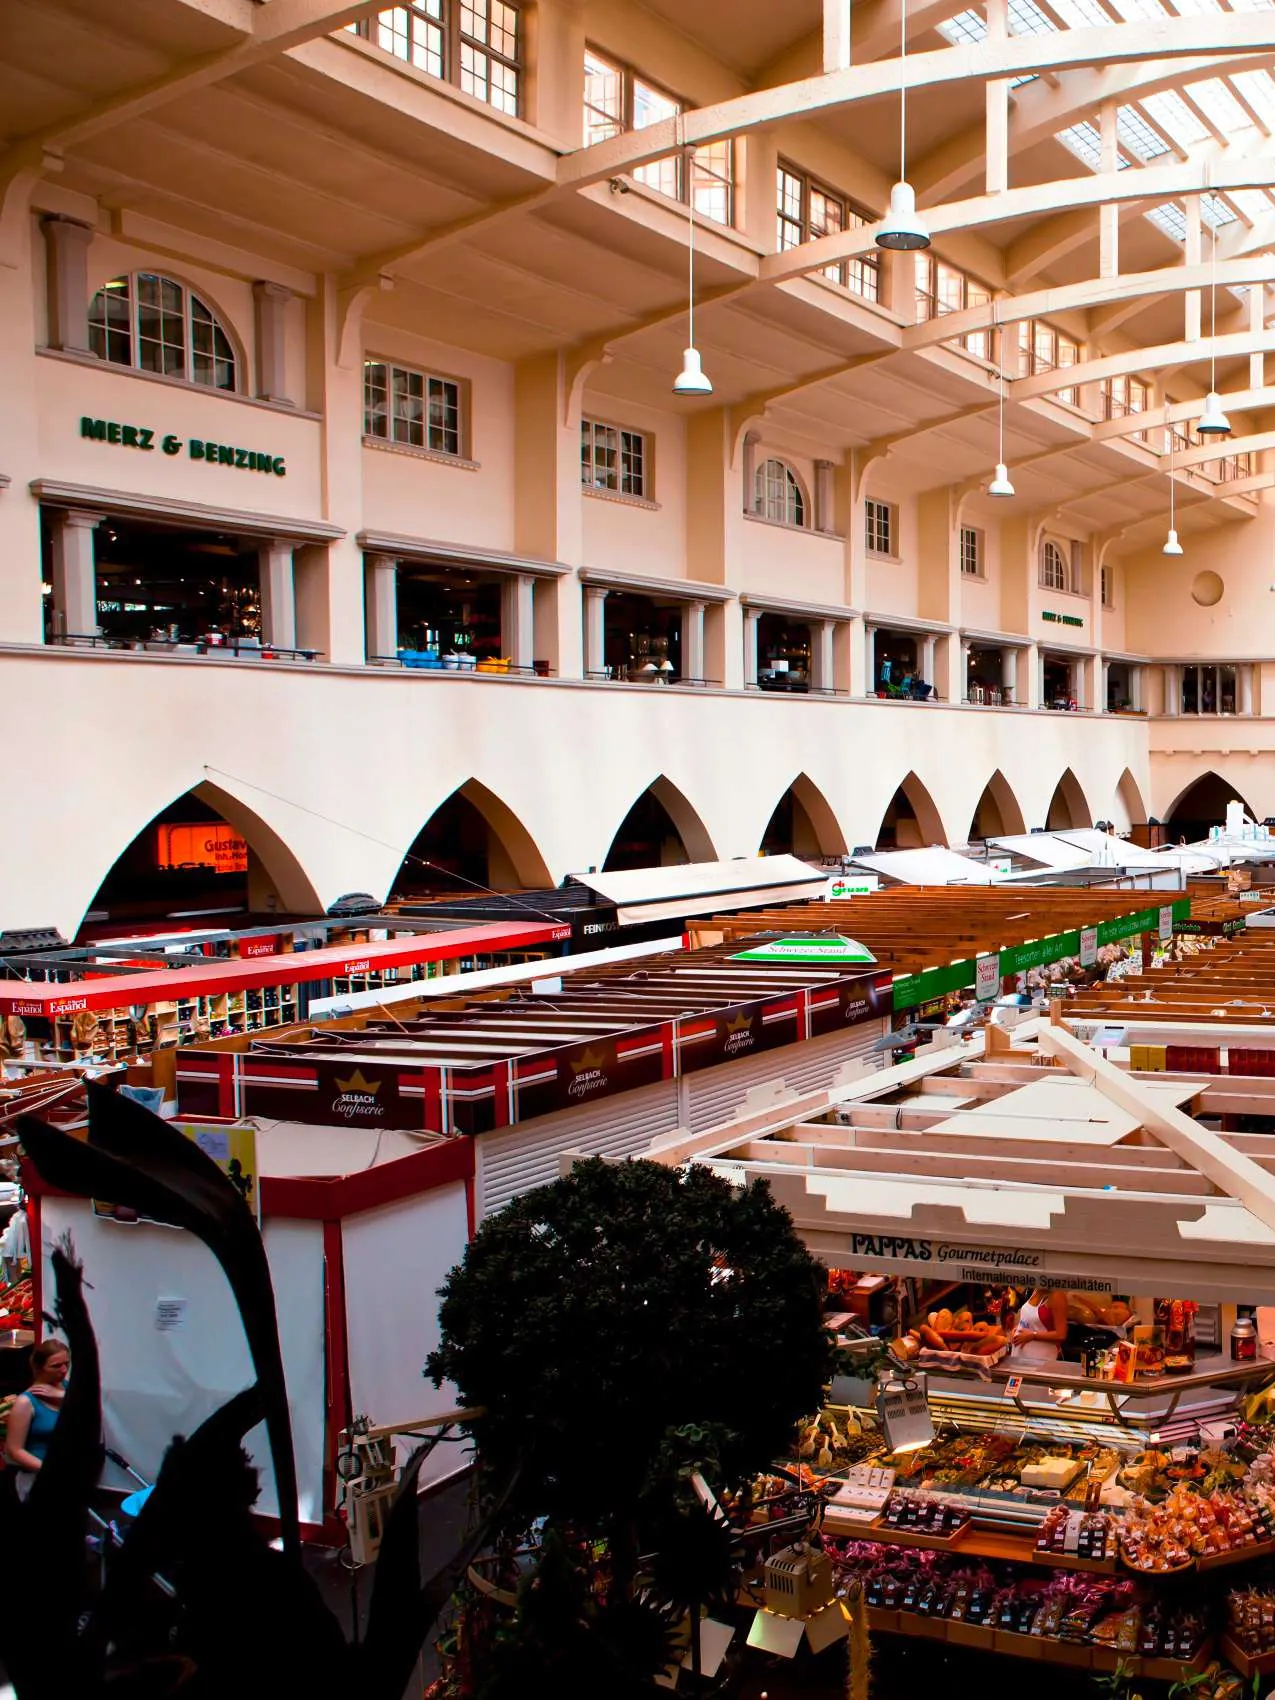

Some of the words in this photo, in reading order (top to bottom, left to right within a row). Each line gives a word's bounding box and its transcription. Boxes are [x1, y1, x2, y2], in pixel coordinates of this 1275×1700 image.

[80, 416, 155, 450] MERZ
[161, 435, 183, 455] &
[188, 438, 287, 477] BENZING
[575, 1069, 601, 1083] SELBACH
[332, 1097, 385, 1118] Confiserie
[341, 1094, 375, 1104] SELBACH
[851, 1232, 932, 1261] PAPPAS
[937, 1243, 1040, 1267] Gourmetpalace
[961, 1267, 1036, 1287] Internationale
[1039, 1274, 1112, 1293] Spezialitäten
